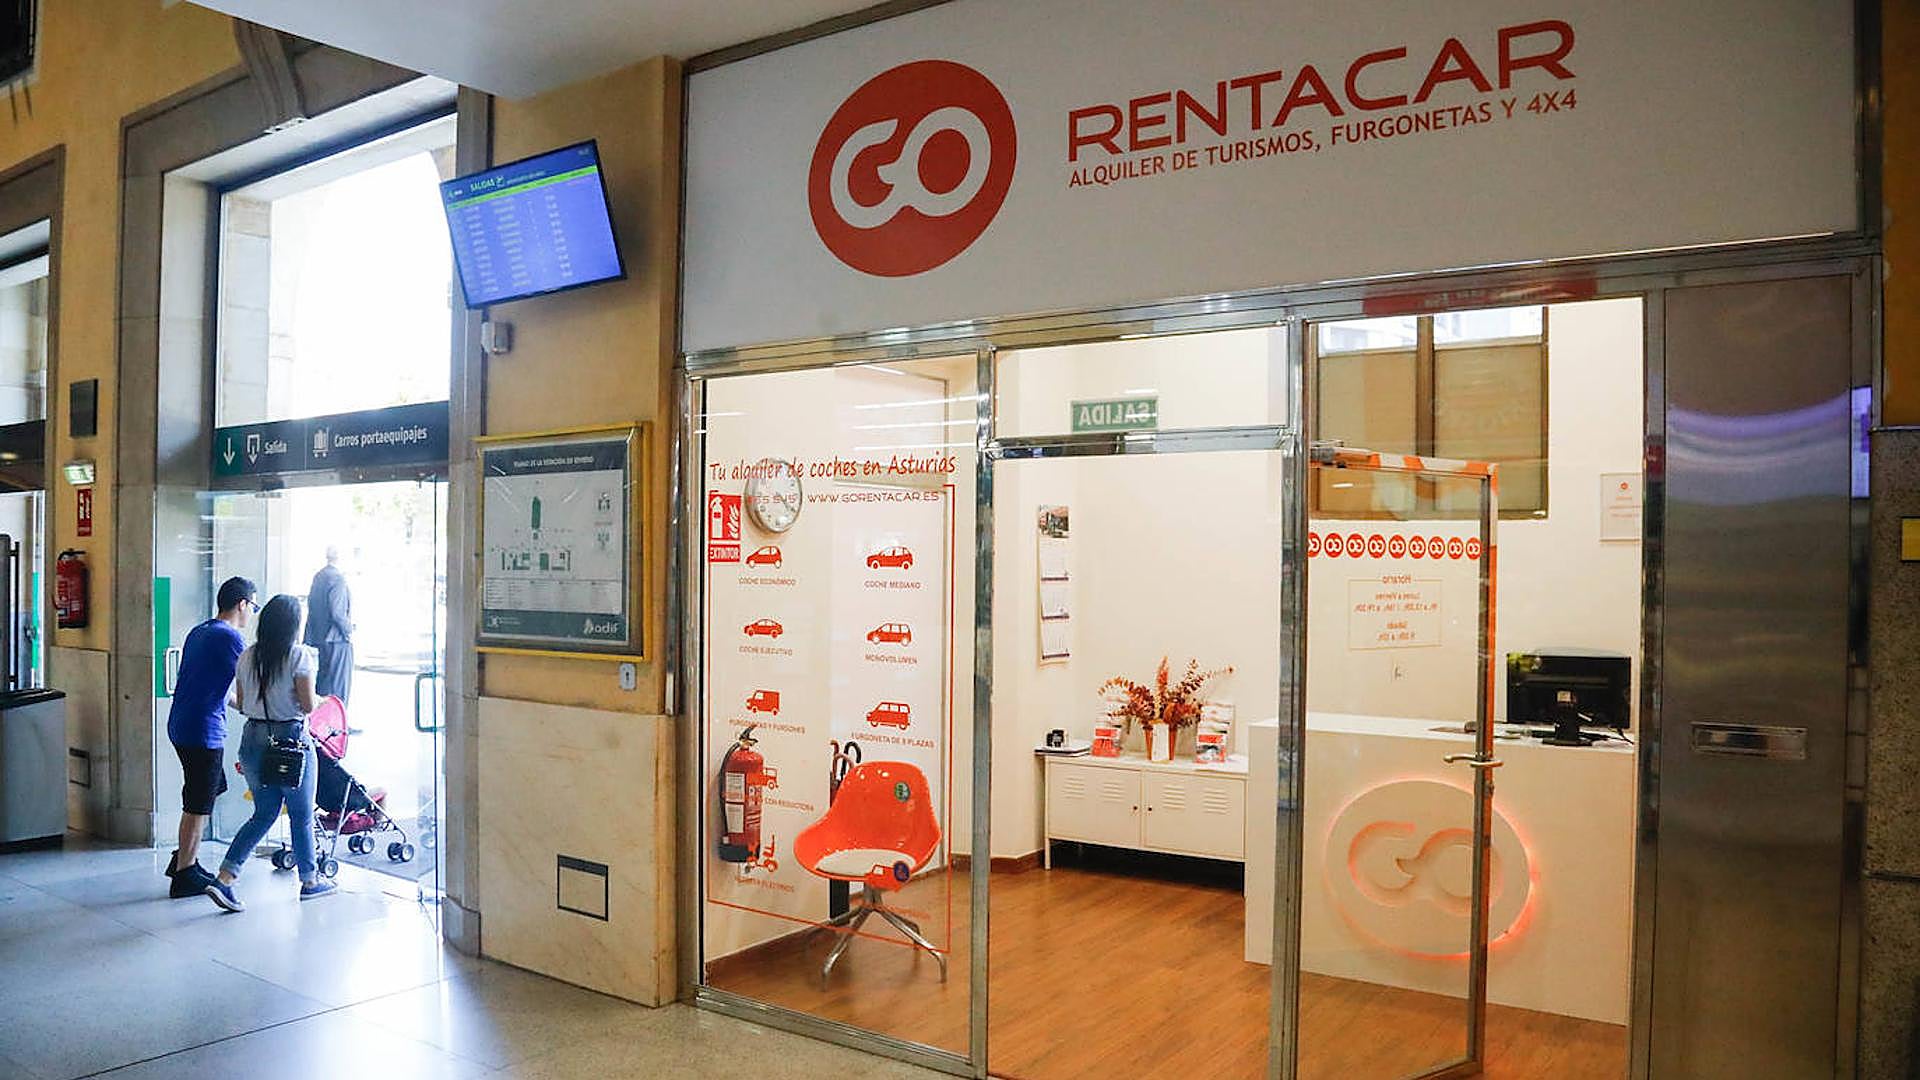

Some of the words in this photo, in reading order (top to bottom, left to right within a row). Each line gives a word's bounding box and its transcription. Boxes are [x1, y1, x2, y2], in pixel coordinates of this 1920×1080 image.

[1067, 19, 1576, 161] RENTACAR
[1070, 155, 1165, 188] ALQUILER
[1172, 149, 1198, 171] DE
[1206, 130, 1321, 165] TURISMOS,
[1331, 102, 1492, 145] FURGONETAS
[1502, 96, 1516, 121] Y
[1527, 88, 1577, 115] 4X4
[829, 106, 991, 229] GO
[264, 440, 288, 454] Salida
[334, 432, 360, 448] Carros
[361, 425, 428, 447] portaequipajes
[710, 464, 726, 480] Tu
[732, 459, 783, 481] alquiler
[787, 458, 804, 478] de
[810, 457, 857, 478] coches
[863, 462, 882, 477] en
[889, 452, 956, 476] Asturias
[593, 621, 618, 635] adif
